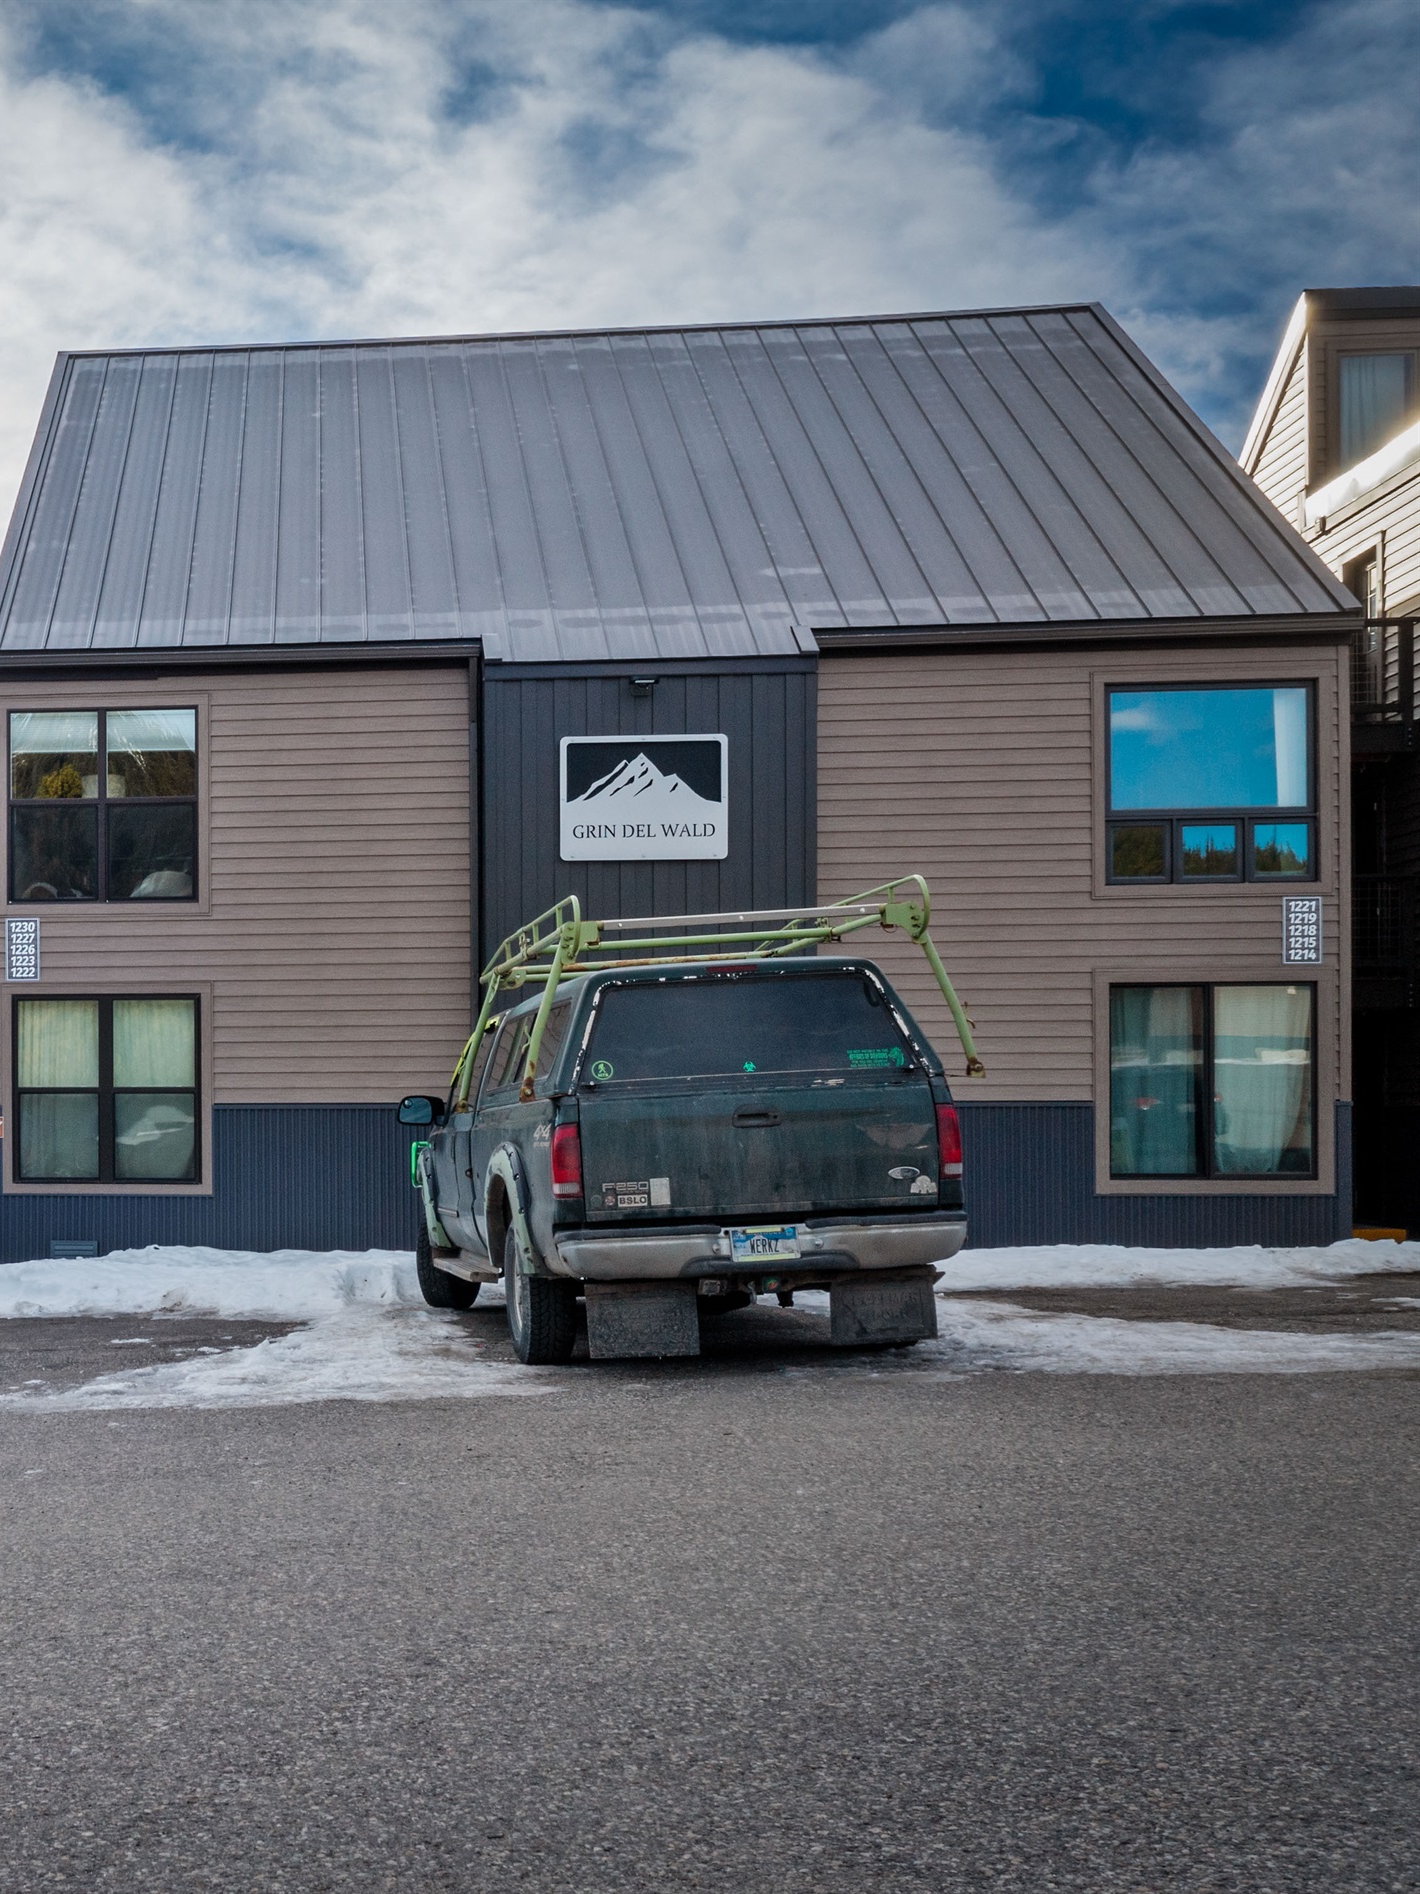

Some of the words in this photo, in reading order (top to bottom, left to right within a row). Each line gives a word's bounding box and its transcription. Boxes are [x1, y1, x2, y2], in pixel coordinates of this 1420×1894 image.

[572, 824, 617, 839] GRIN
[623, 823, 657, 838] DEL
[661, 823, 716, 837] WALD
[1289, 901, 1316, 911] 1221
[1289, 913, 1317, 923] 1219
[10, 922, 35, 932] 1230
[1289, 925, 1317, 936] 1218
[10, 933, 35, 944] 1227
[1289, 937, 1317, 948] 1215
[10, 944, 35, 955] 1226
[1289, 949, 1317, 960] 1214
[10, 956, 35, 966] 1223
[10, 967, 35, 977] 1222
[619, 1196, 647, 1205] BSLO
